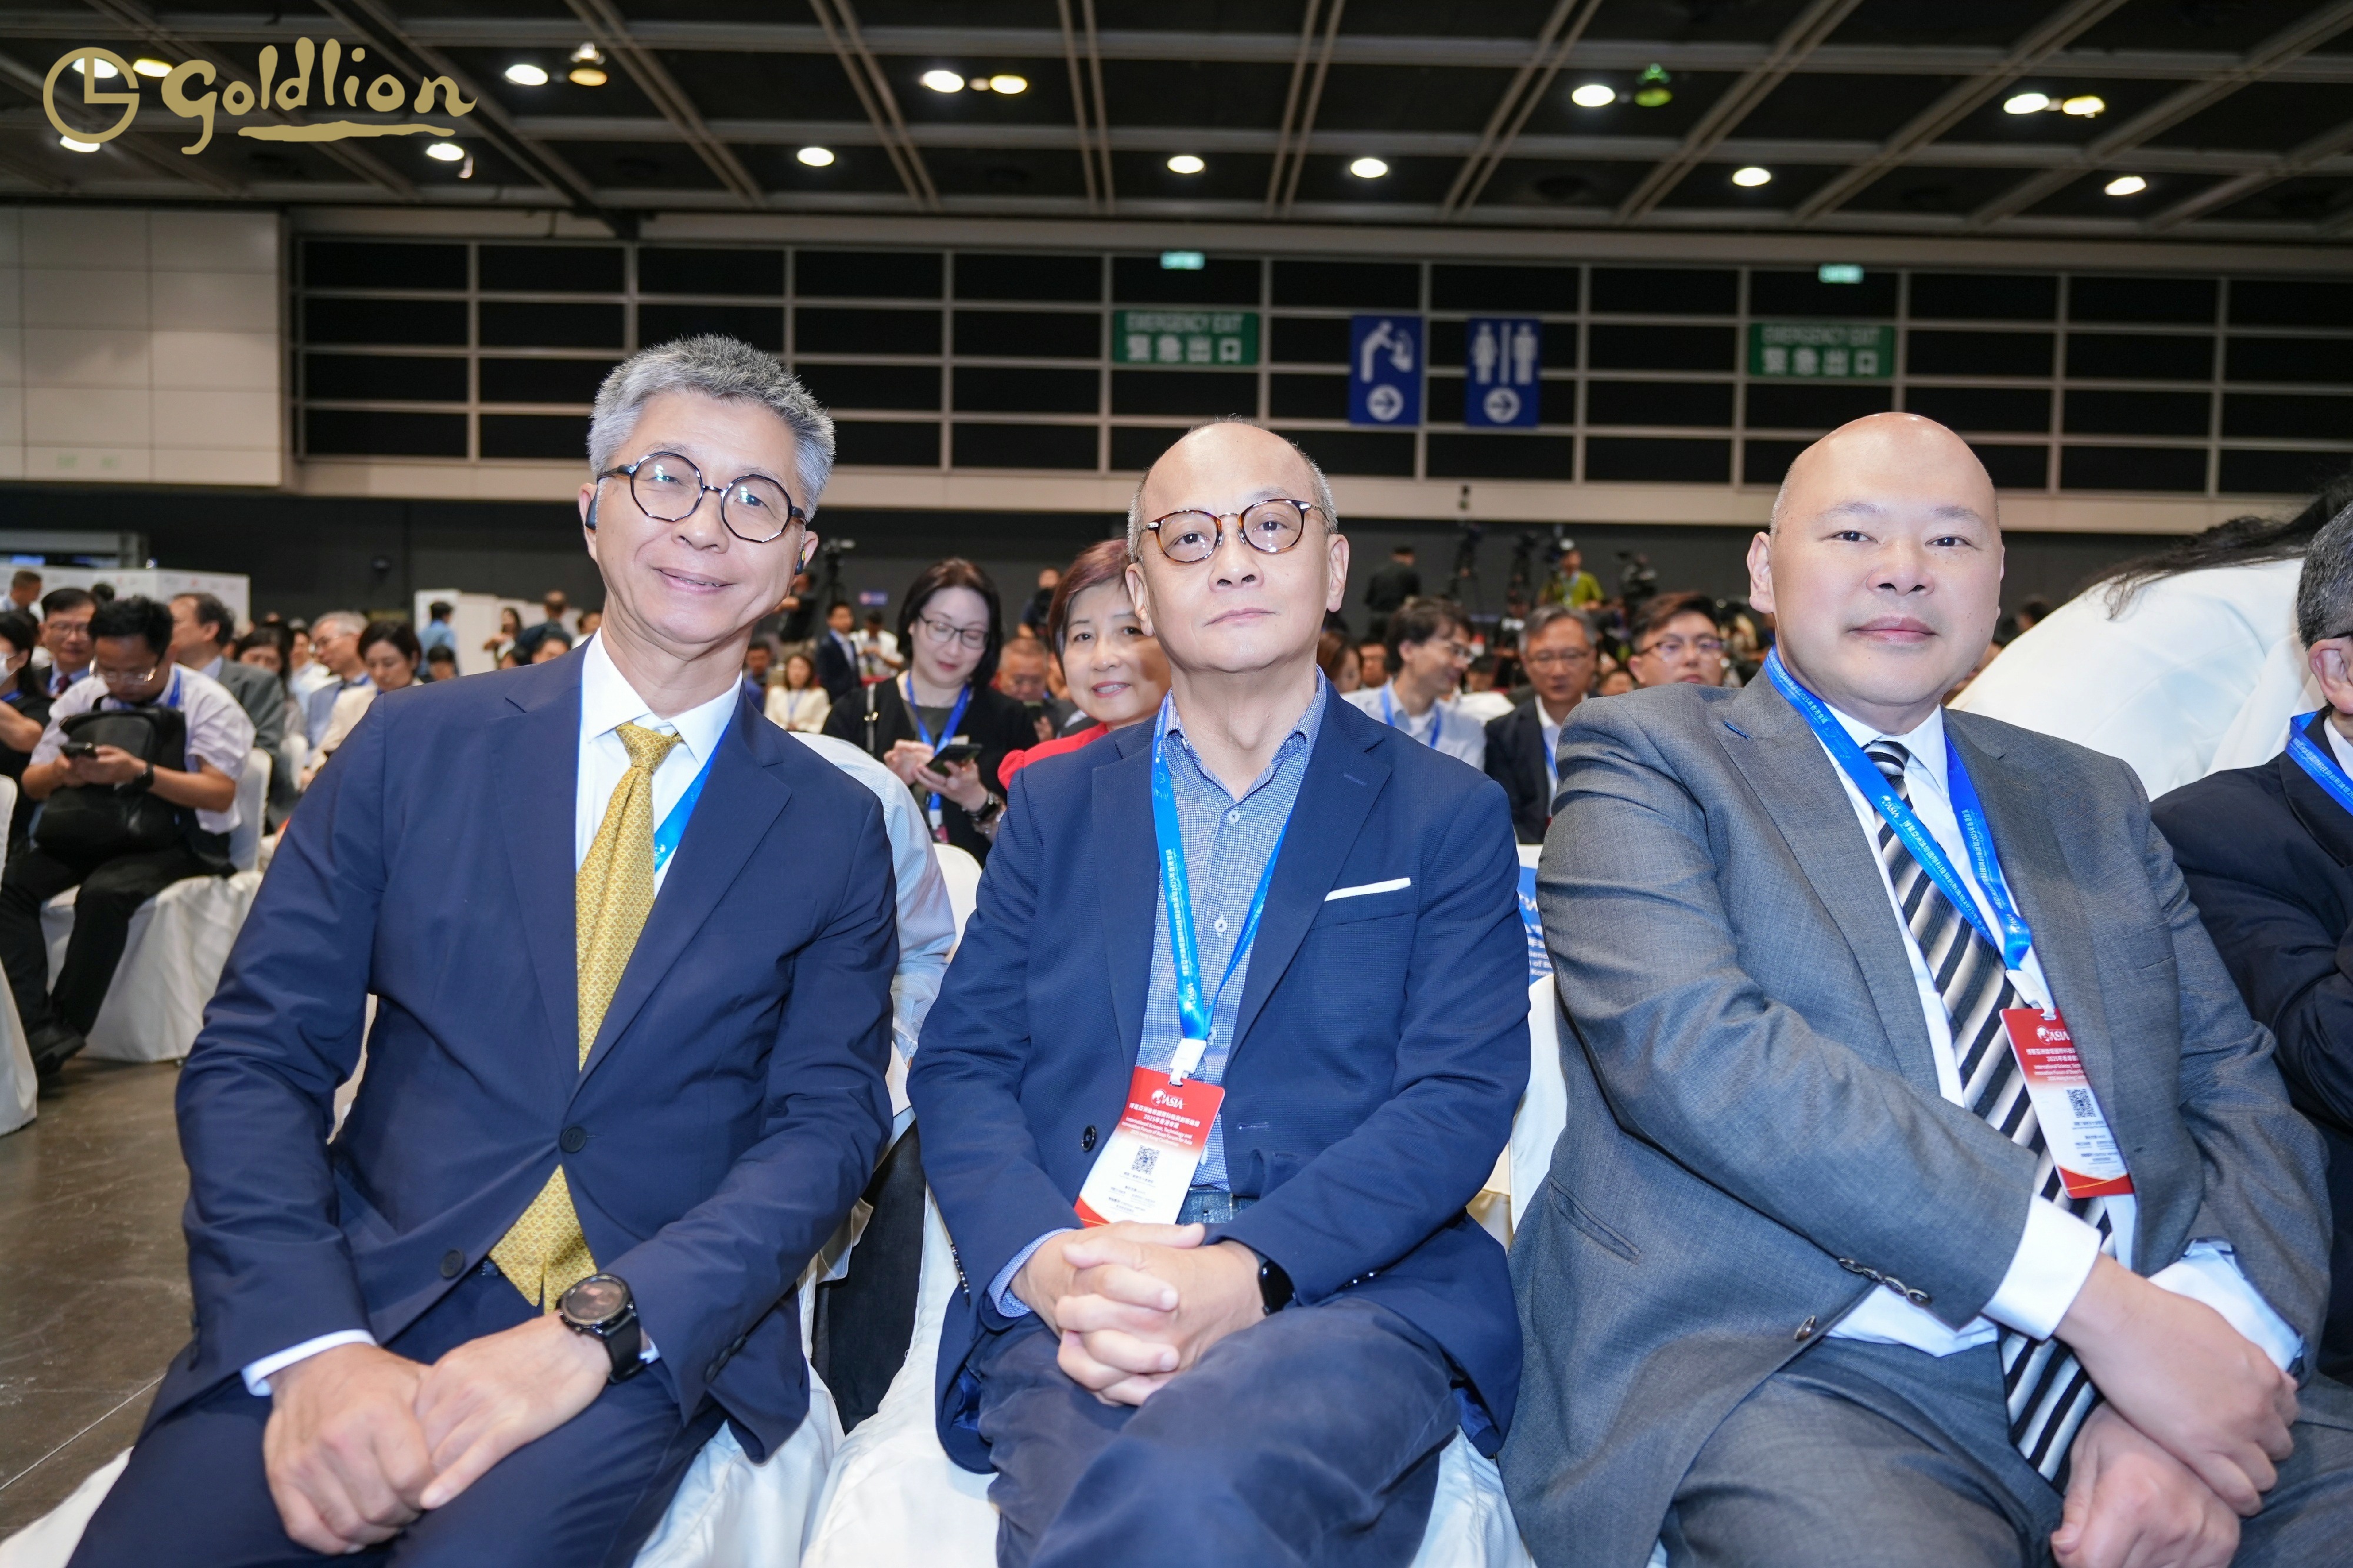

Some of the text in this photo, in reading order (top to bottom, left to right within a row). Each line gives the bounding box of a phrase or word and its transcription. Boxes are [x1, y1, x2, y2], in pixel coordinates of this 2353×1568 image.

[1884, 802, 1901, 819] ASIA
[1186, 982, 1195, 1000] ASIA
[1161, 1094, 1184, 1109] ASIA
